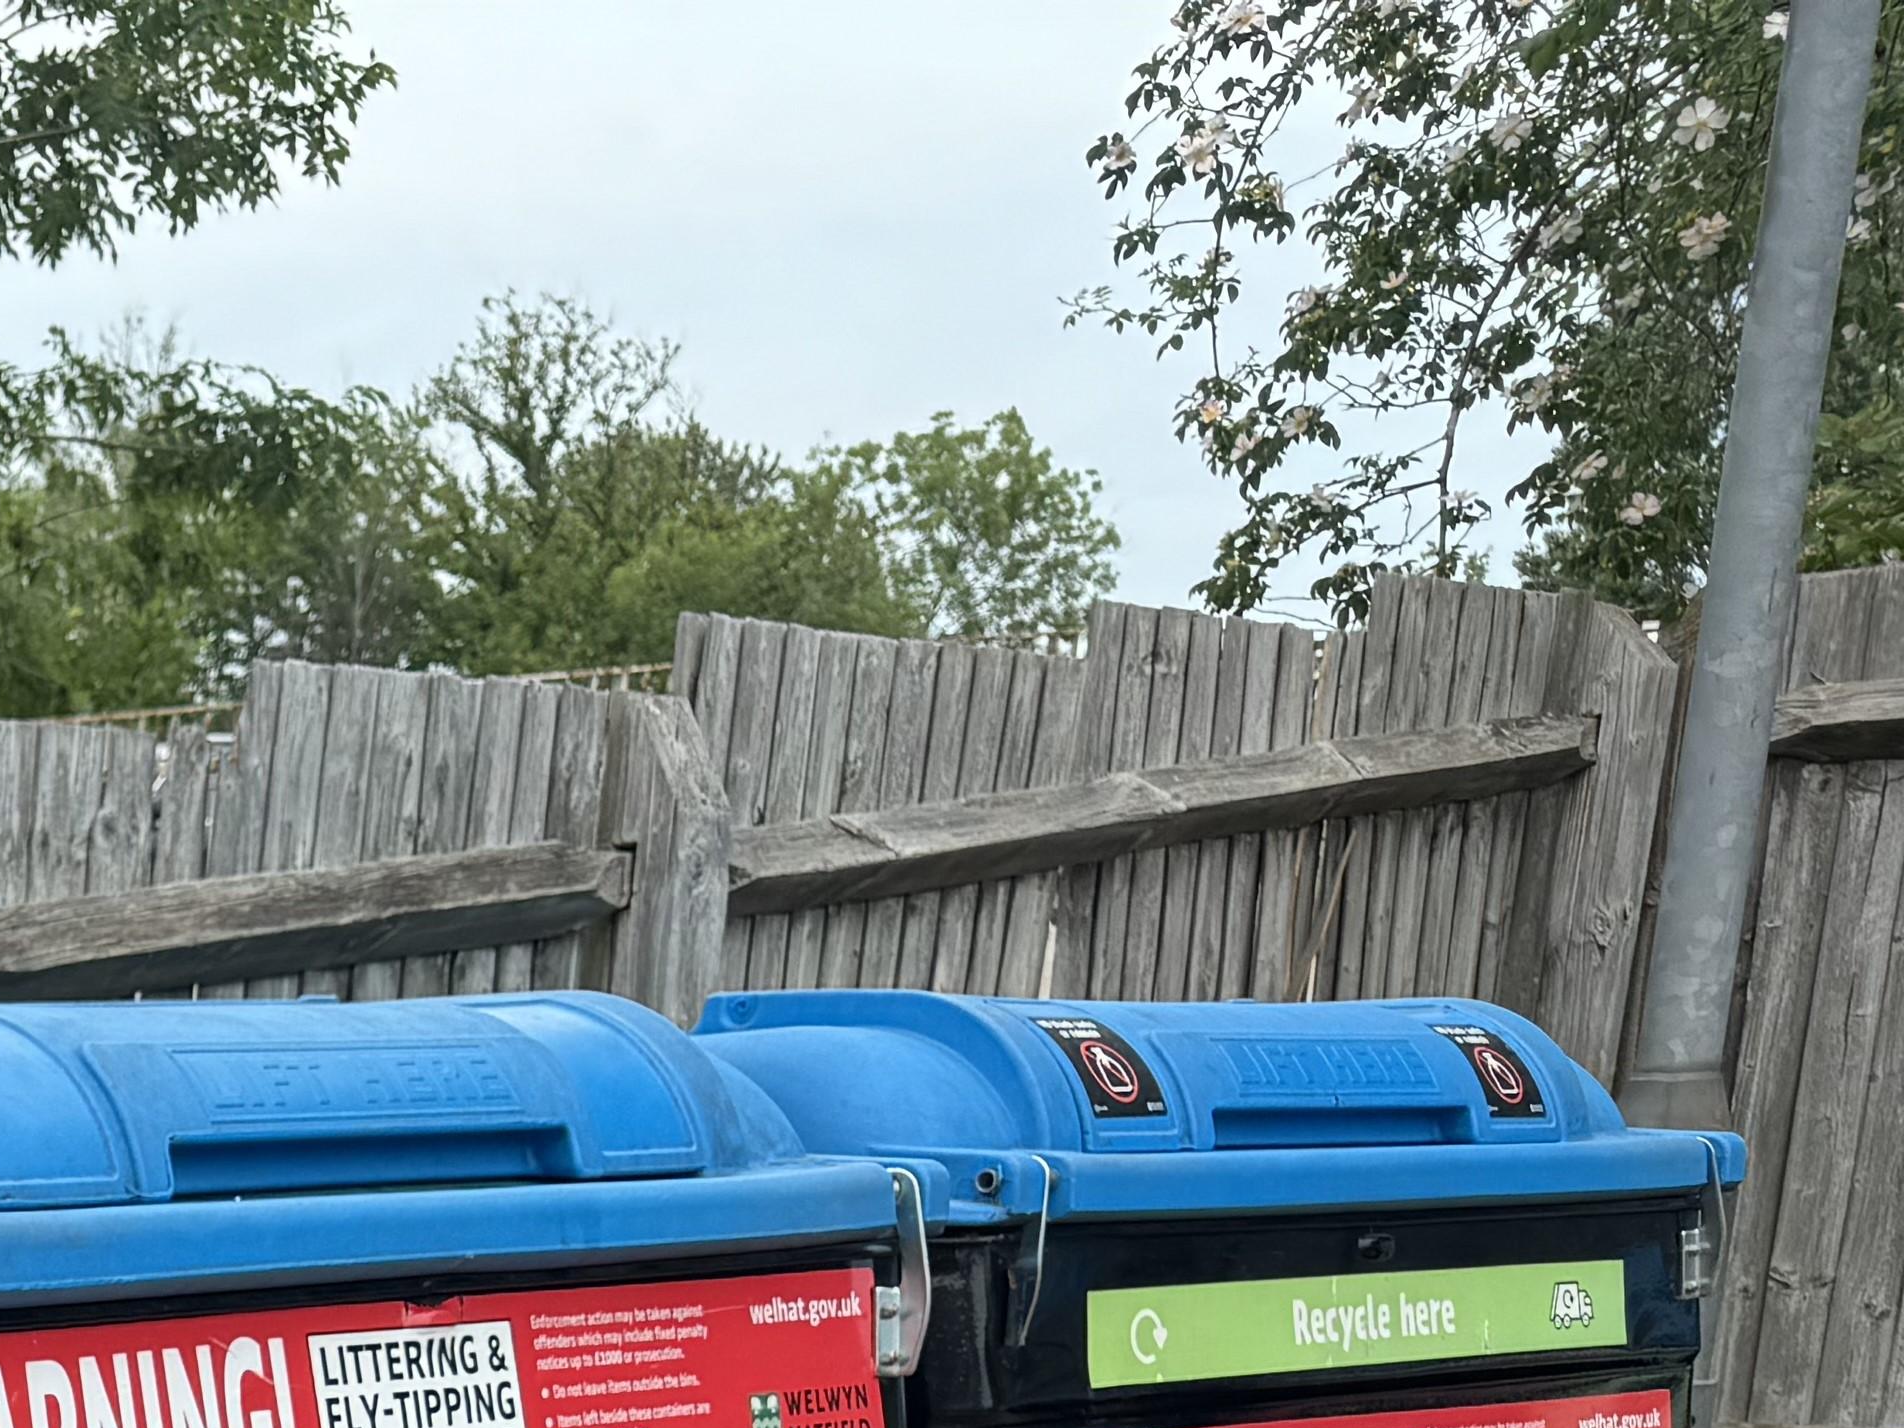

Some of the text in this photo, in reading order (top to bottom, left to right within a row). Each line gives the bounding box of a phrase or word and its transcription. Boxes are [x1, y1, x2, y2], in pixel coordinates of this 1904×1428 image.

[750, 1291, 862, 1327] welhat.gov.uk
[1293, 1293, 1456, 1349] Recycle here
[320, 1335, 511, 1387] LITTERING &
[784, 1384, 869, 1416] WELWYN
